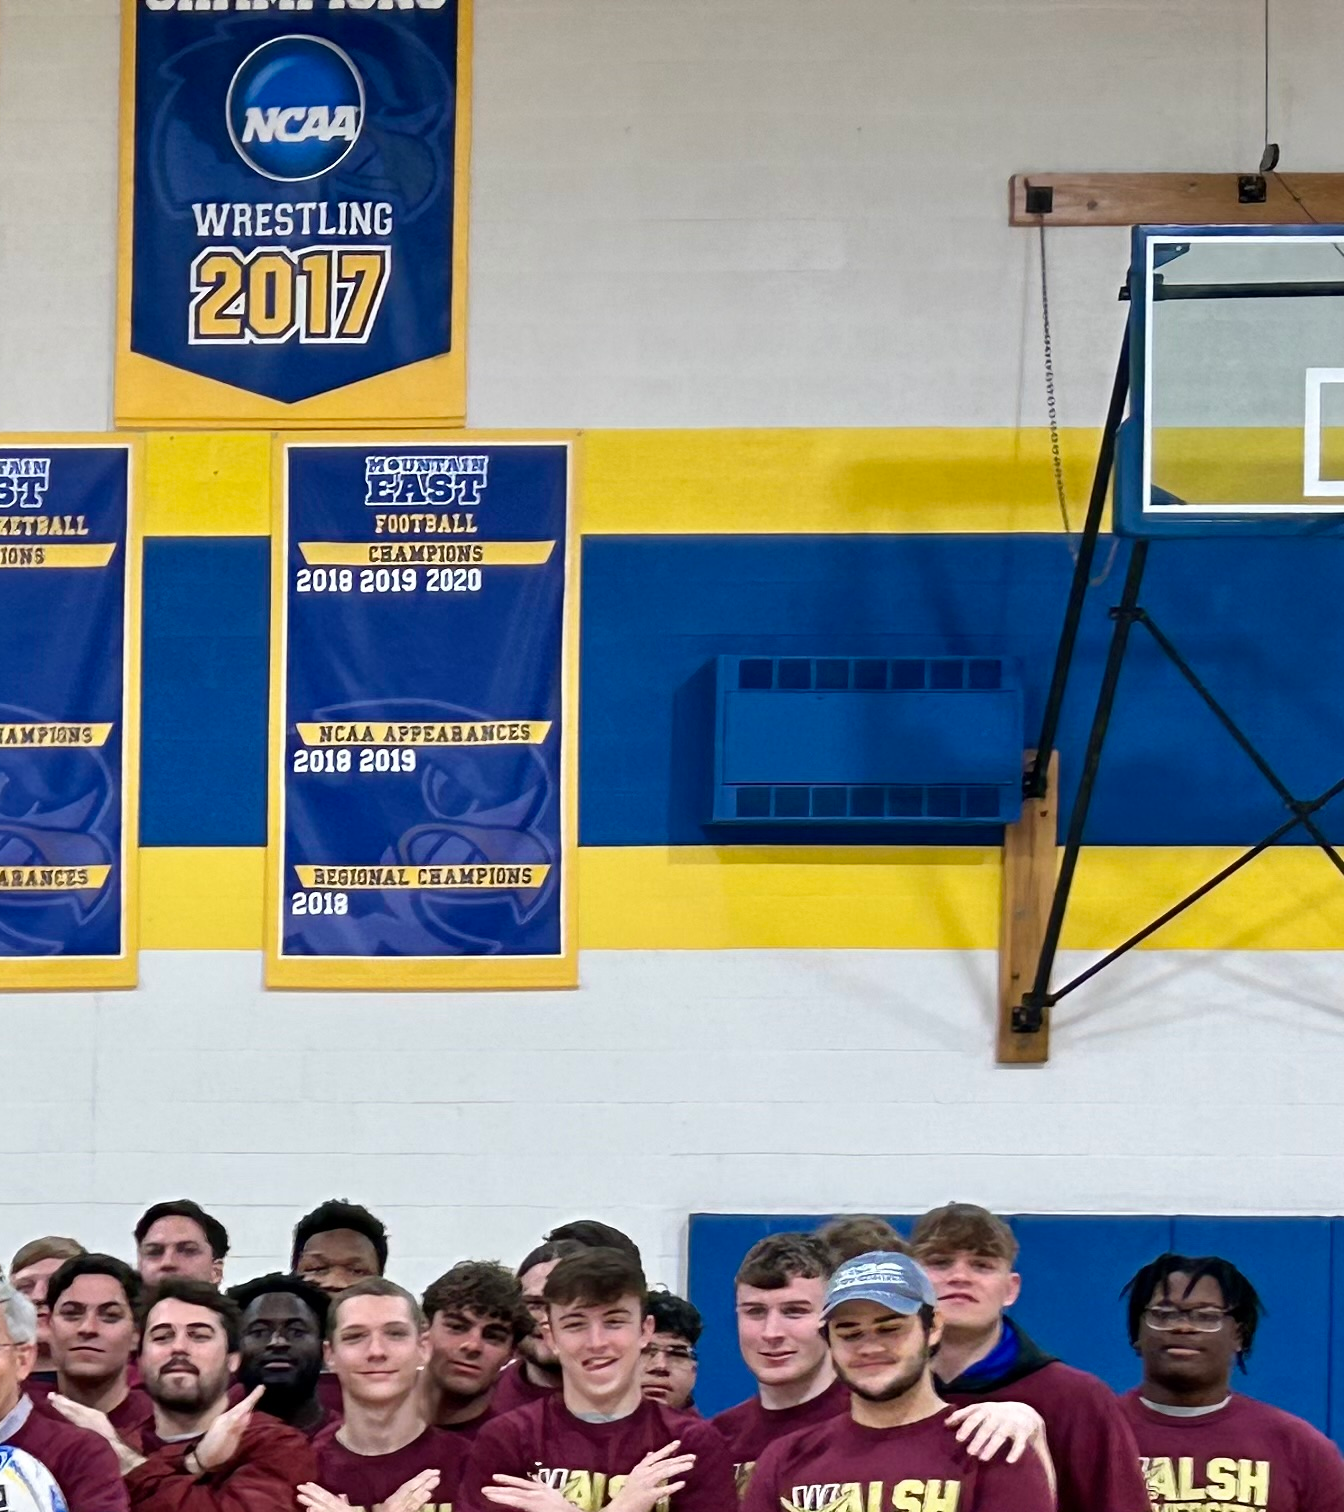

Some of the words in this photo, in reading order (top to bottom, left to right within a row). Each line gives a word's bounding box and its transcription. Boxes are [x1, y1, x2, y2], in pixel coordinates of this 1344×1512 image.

[241, 107, 358, 144] NCAA
[192, 203, 392, 238] WRESTLING
[188, 245, 391, 345] 2017
[366, 474, 487, 506] EAST
[375, 513, 477, 534] FOOTBALL
[368, 544, 483, 564] CHAMPIONS
[297, 569, 352, 593] 2018
[359, 569, 416, 592] 2019
[427, 569, 482, 592] 2020
[319, 723, 376, 743] NCAA
[383, 723, 530, 743] APPEARANCES
[294, 749, 350, 773] 2018
[359, 749, 415, 773] 2019
[417, 867, 532, 887] CHAMPIONS
[292, 891, 347, 915] 2018
